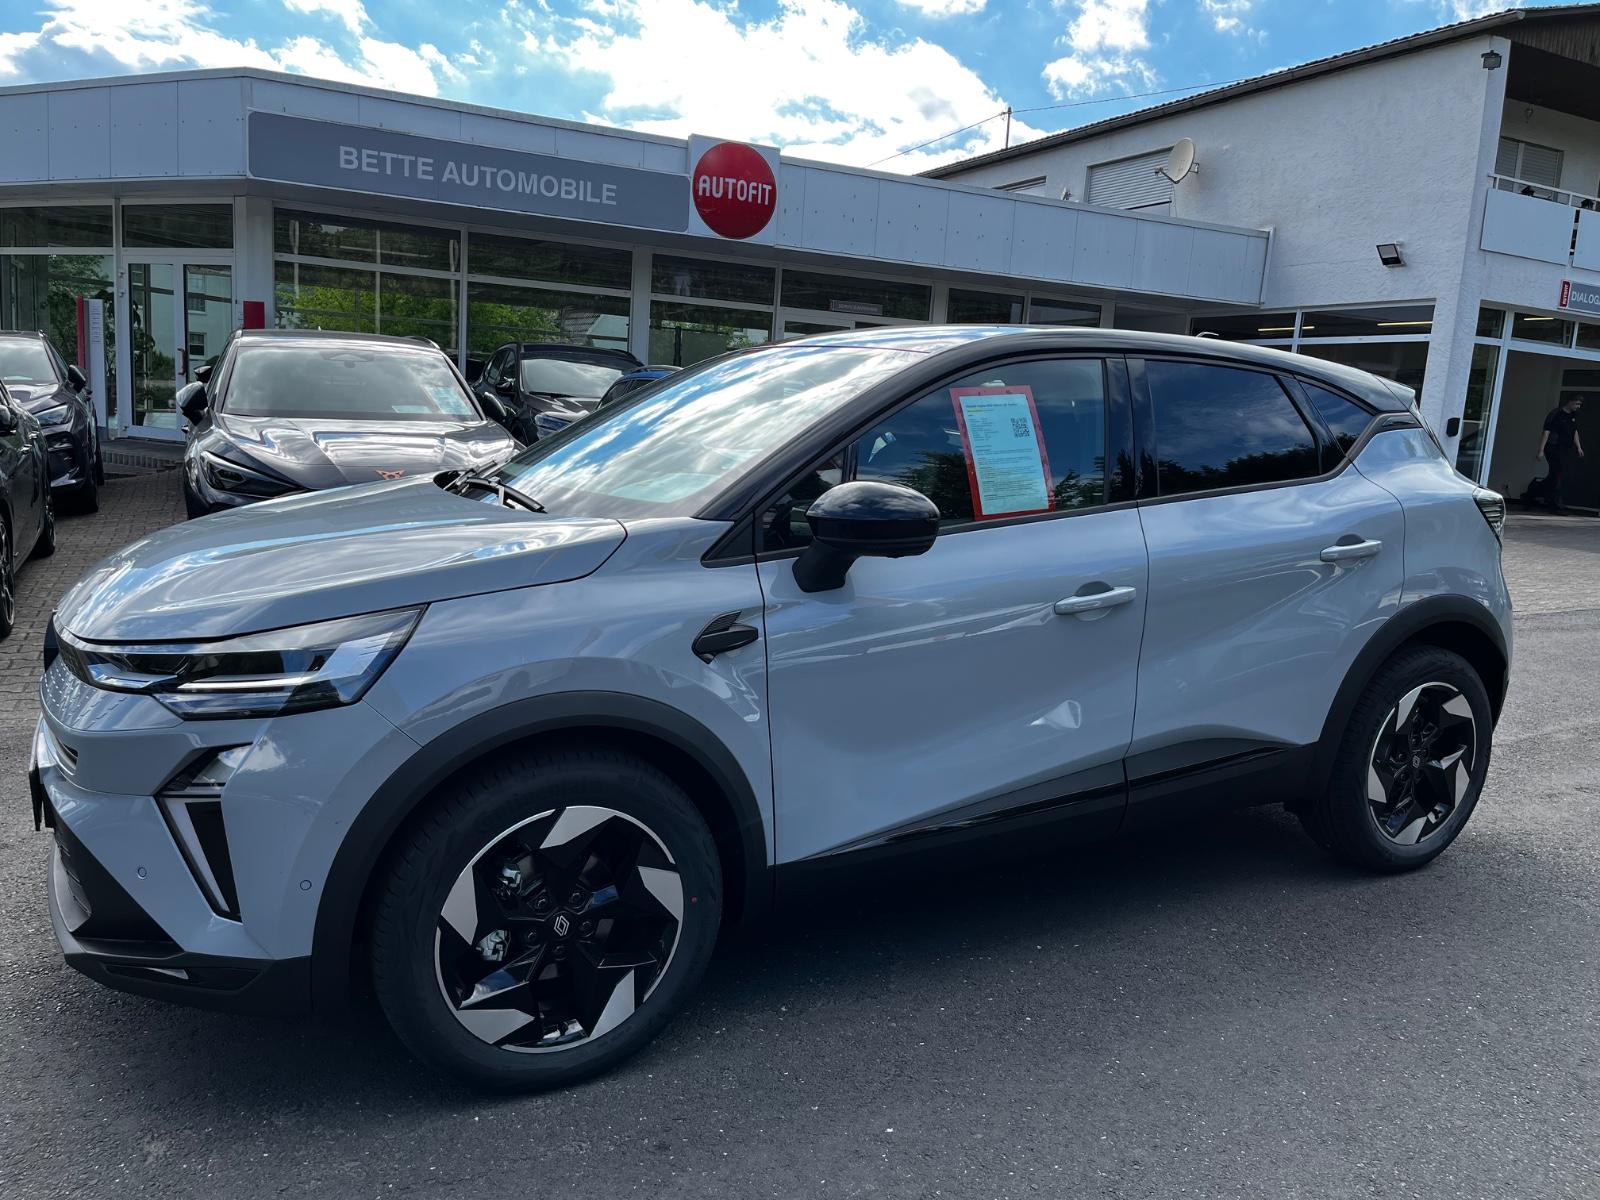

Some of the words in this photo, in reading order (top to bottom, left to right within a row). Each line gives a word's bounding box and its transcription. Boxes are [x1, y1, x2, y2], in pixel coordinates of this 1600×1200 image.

[339, 146, 434, 180] BETTE
[441, 161, 617, 205] AUTOMOBILE
[698, 175, 772, 205] AUTOFIT
